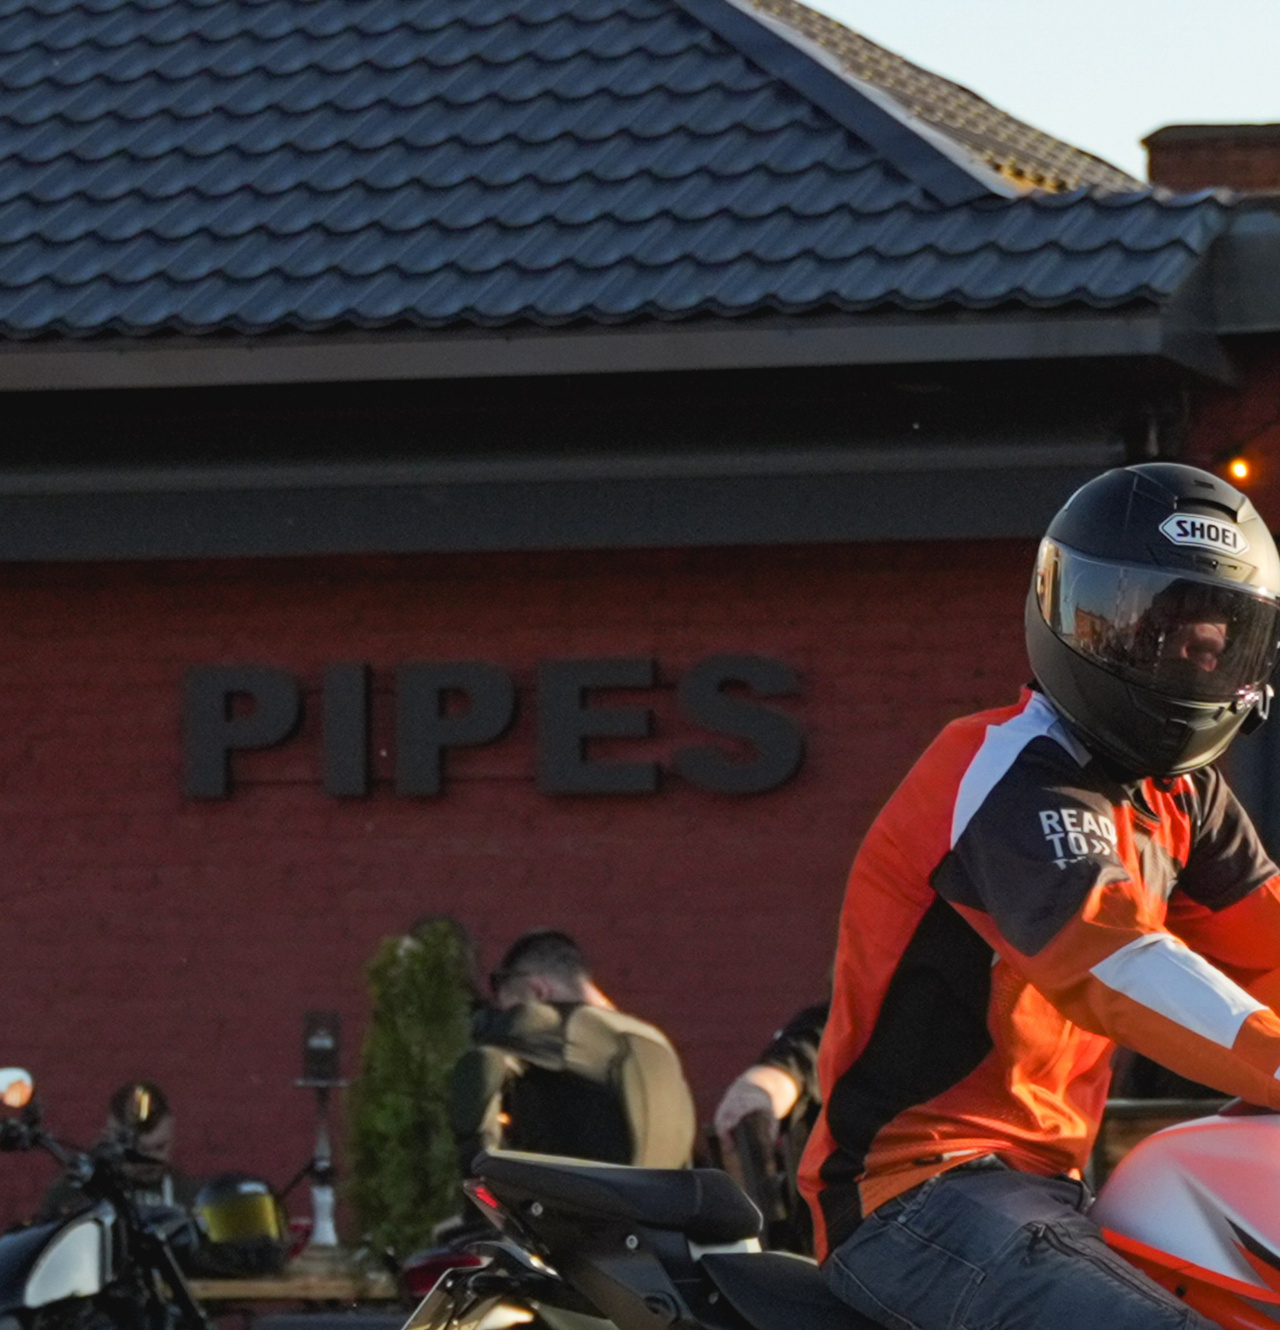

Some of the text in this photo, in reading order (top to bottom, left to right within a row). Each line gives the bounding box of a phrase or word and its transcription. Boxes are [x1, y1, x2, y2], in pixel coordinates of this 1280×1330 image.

[1175, 519, 1237, 549] SHOEI
[182, 654, 806, 800] PIPES
[1045, 831, 1089, 858] TO
